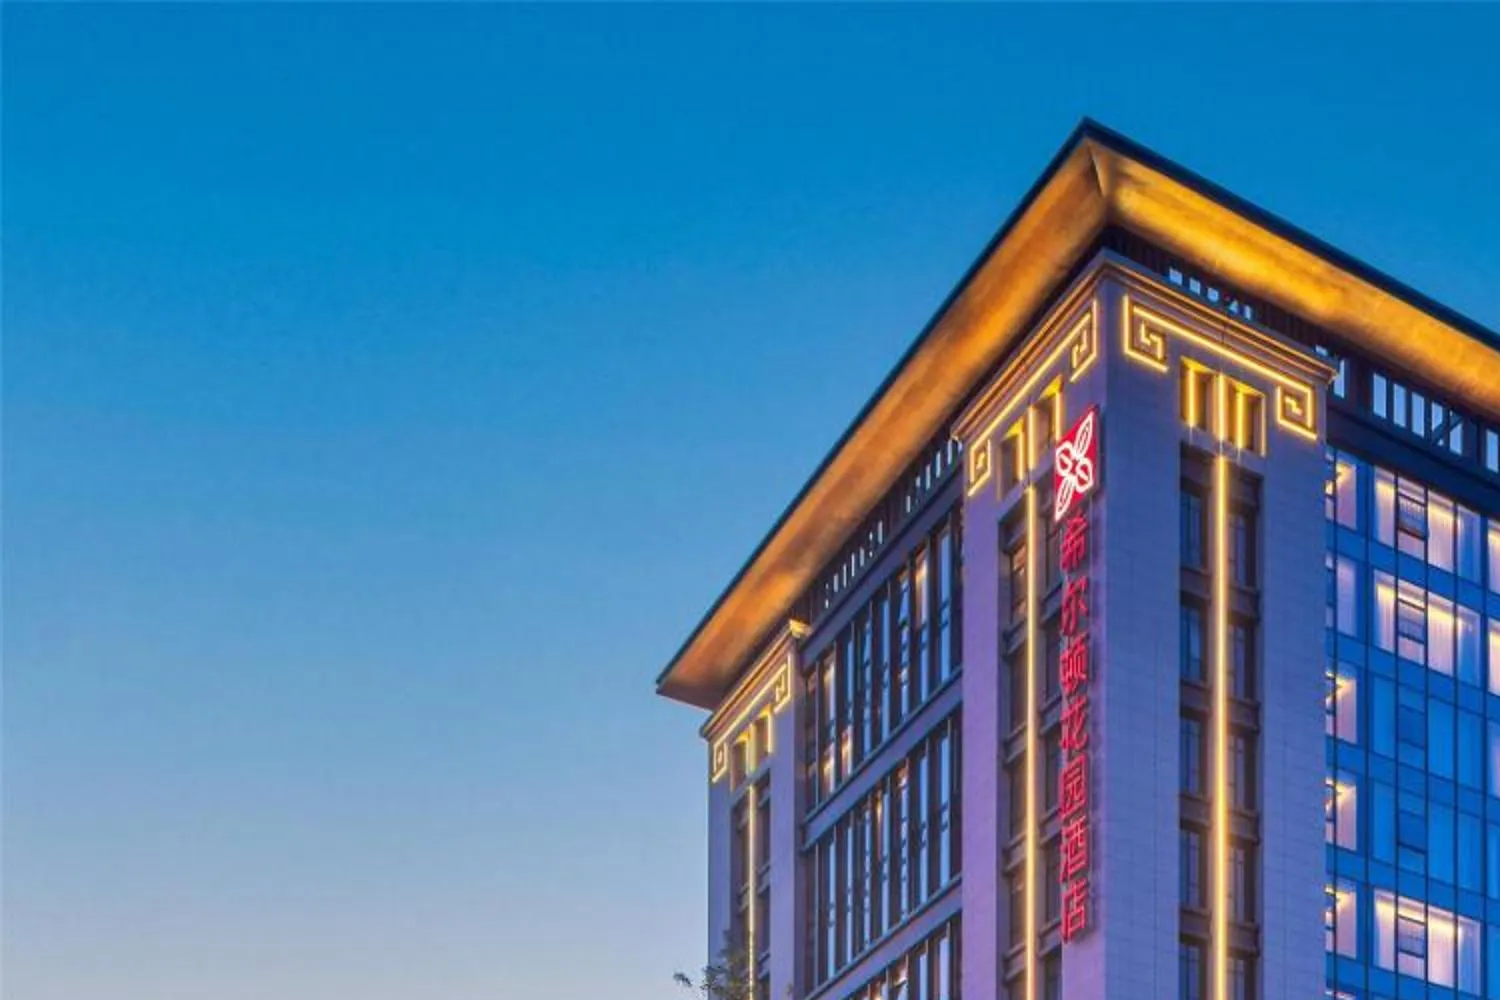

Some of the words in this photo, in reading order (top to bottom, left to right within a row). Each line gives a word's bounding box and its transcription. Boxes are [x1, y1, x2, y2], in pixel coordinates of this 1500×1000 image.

[1059, 509, 1087, 945] 希尔顿花园酒店
